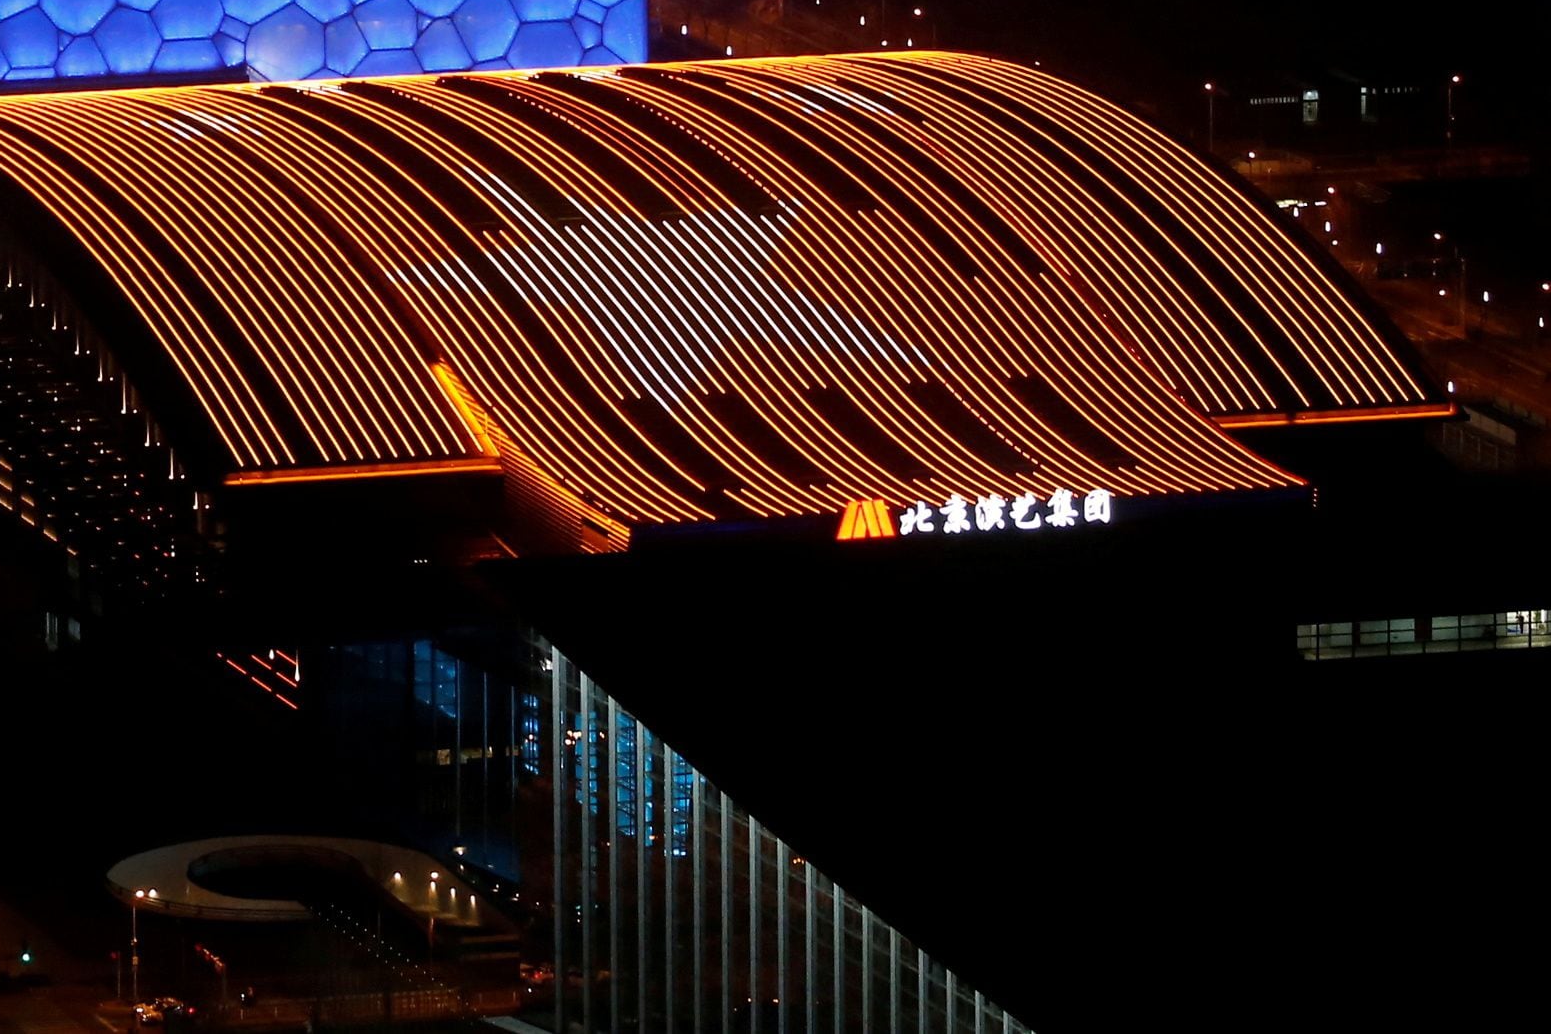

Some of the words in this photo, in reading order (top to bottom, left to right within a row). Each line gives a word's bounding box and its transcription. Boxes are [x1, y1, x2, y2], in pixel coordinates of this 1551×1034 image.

[899, 487, 1112, 536] 北京演艺集团
